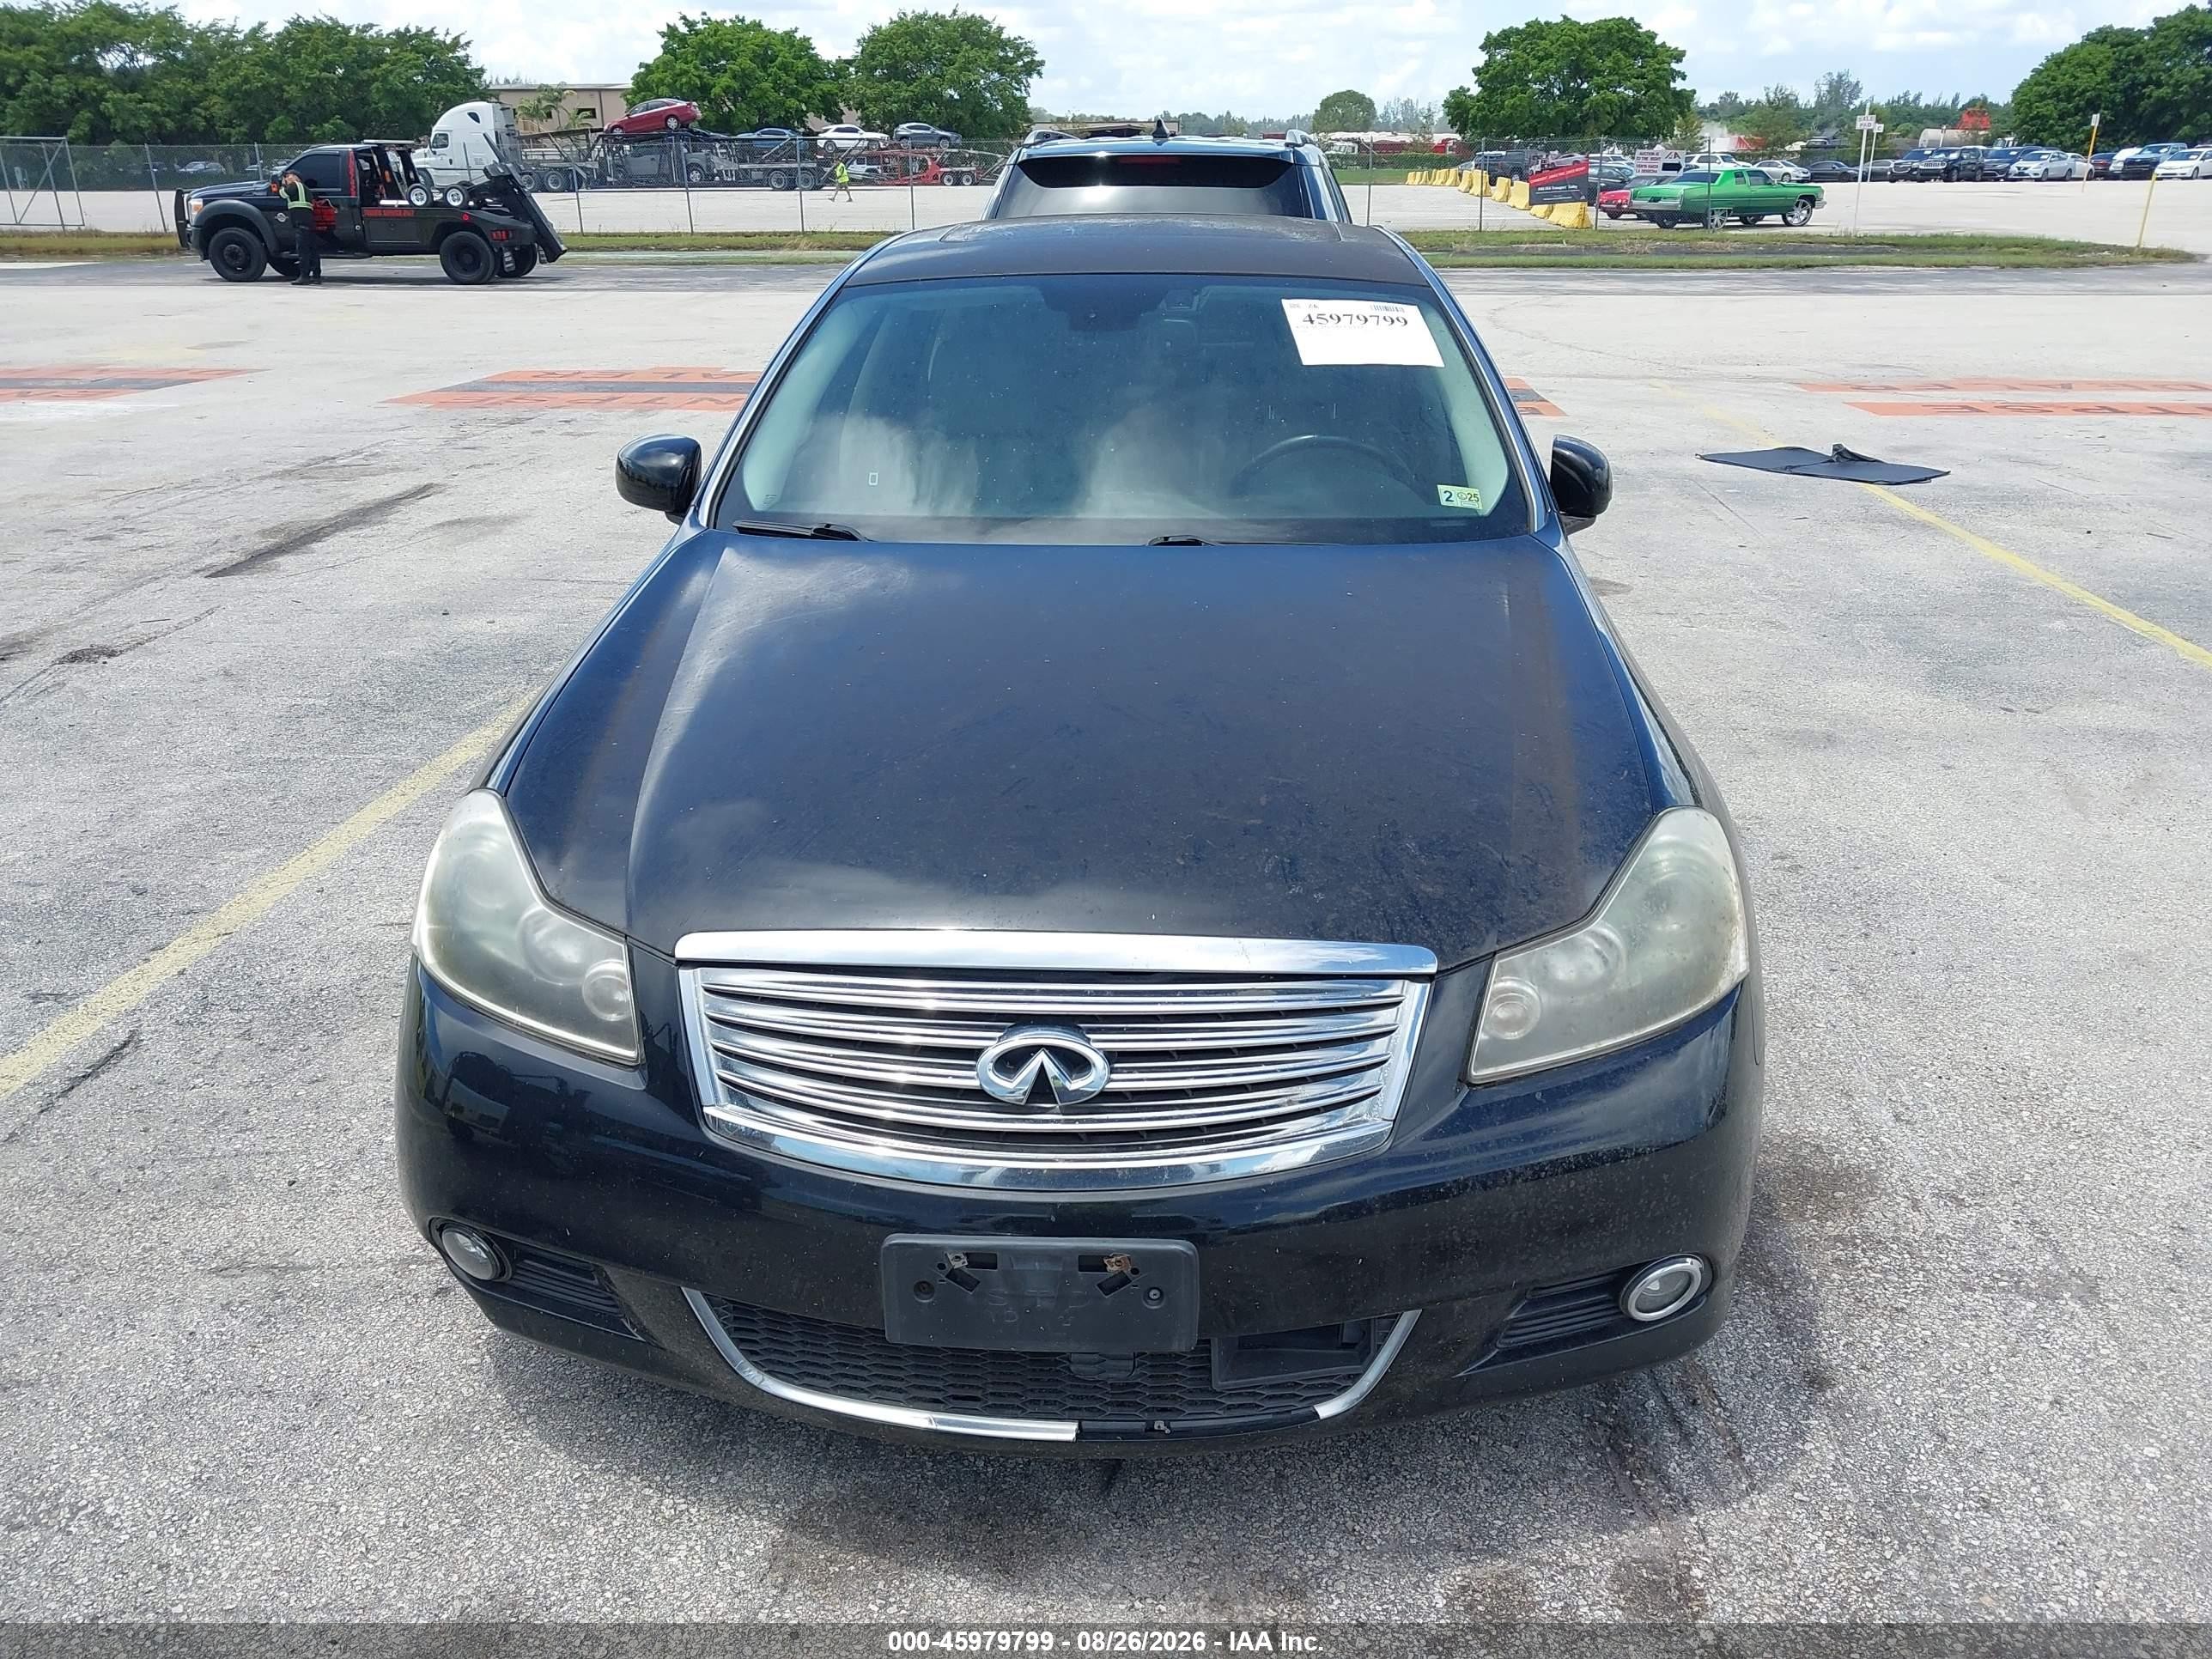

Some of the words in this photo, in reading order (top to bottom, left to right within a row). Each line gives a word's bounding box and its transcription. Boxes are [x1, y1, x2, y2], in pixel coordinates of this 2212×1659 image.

[1302, 313, 1408, 327] 45979799
[532, 371, 757, 381] ALER
[1443, 490, 1455, 502] 2
[1467, 492, 1480, 502] 25
